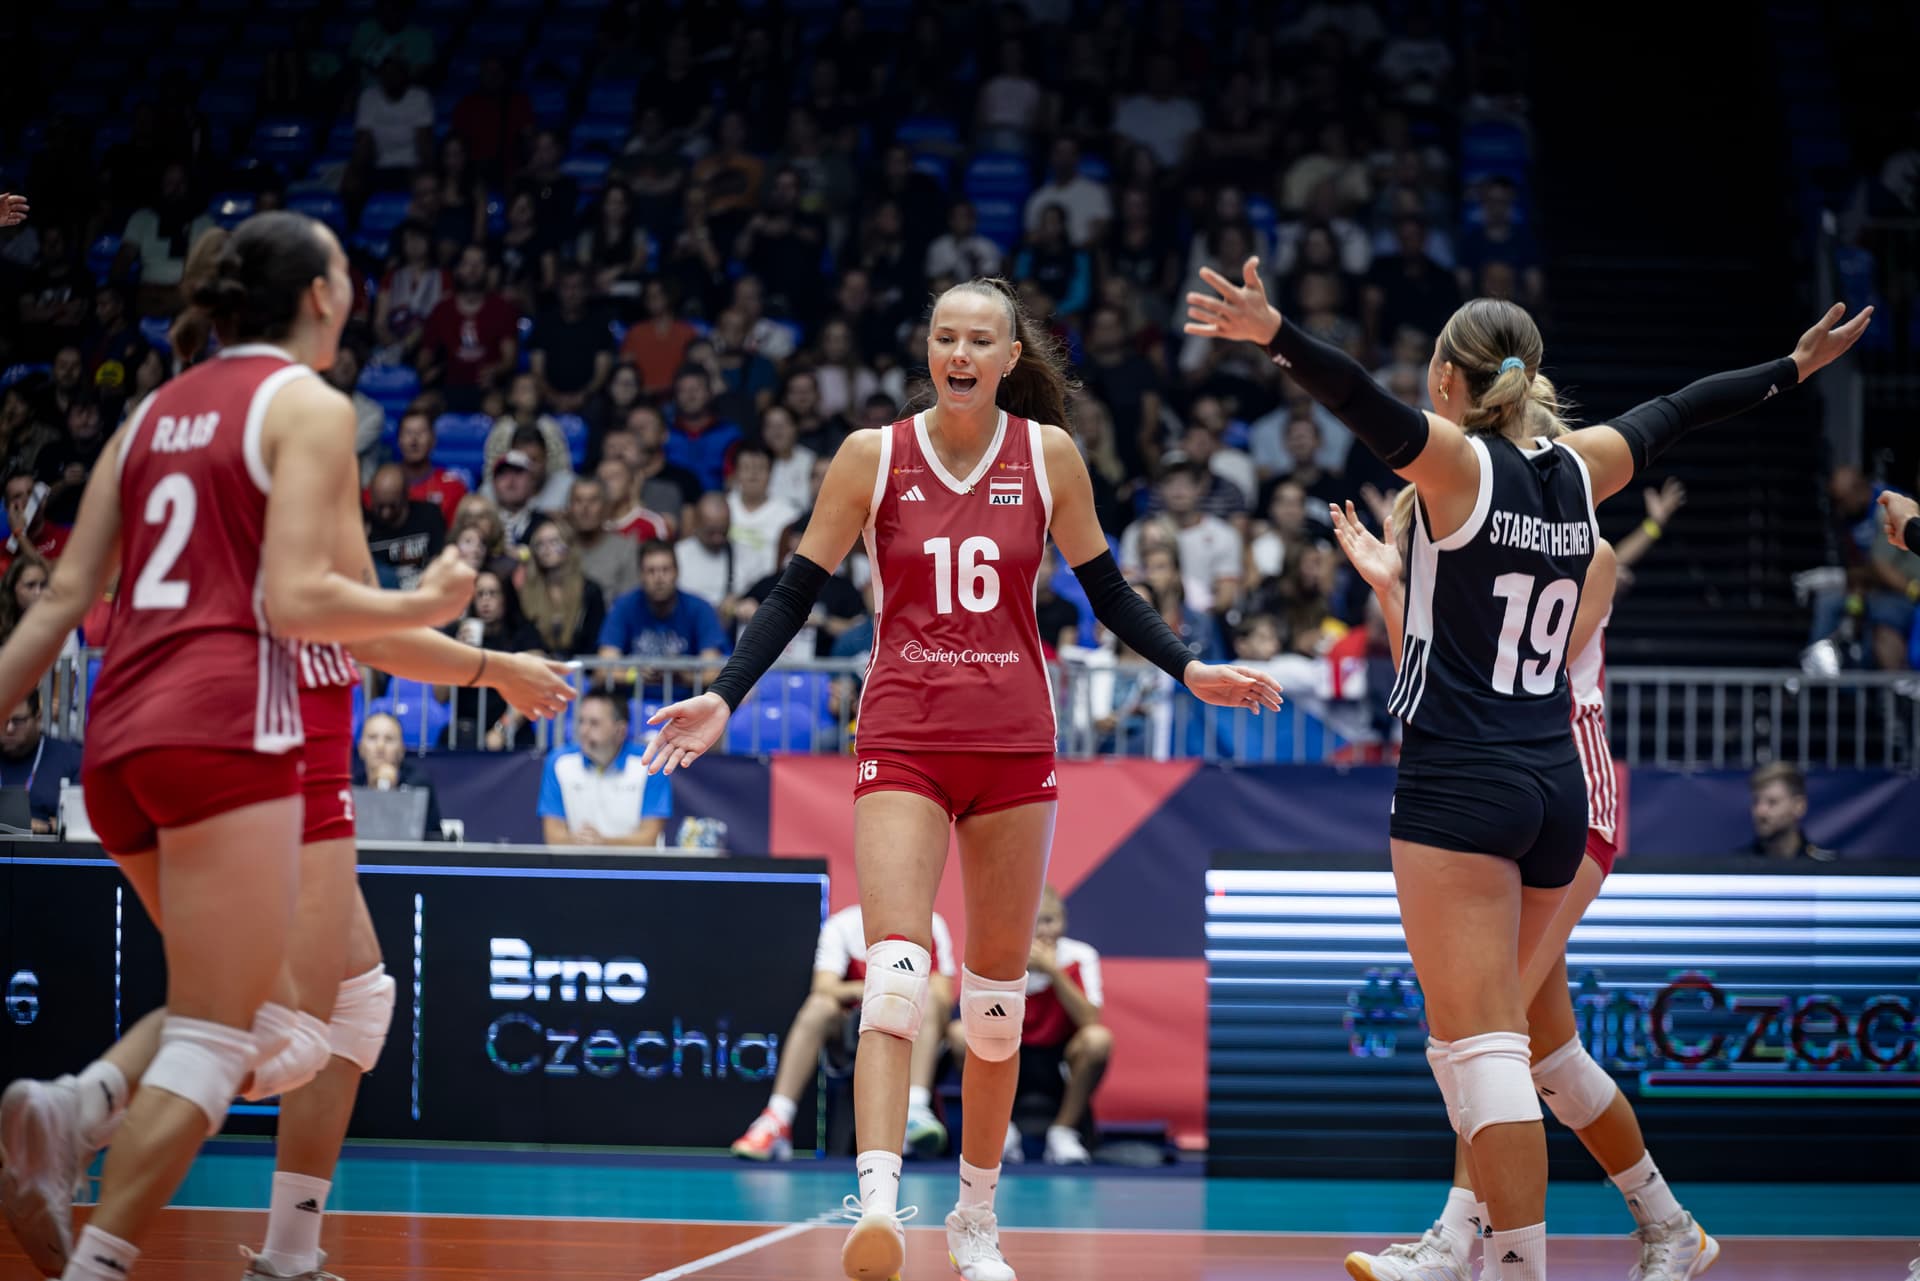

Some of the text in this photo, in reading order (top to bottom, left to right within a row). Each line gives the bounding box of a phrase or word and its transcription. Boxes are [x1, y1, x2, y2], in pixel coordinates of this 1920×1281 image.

[992, 495, 1021, 505] AUT
[132, 471, 198, 610] 2
[923, 535, 1000, 615] 16
[922, 648, 1020, 668] SafetyConcepts
[1492, 572, 1579, 696] 19
[857, 760, 878, 784] 16
[489, 937, 649, 1003] Brno
[486, 1011, 779, 1080] Czechia
